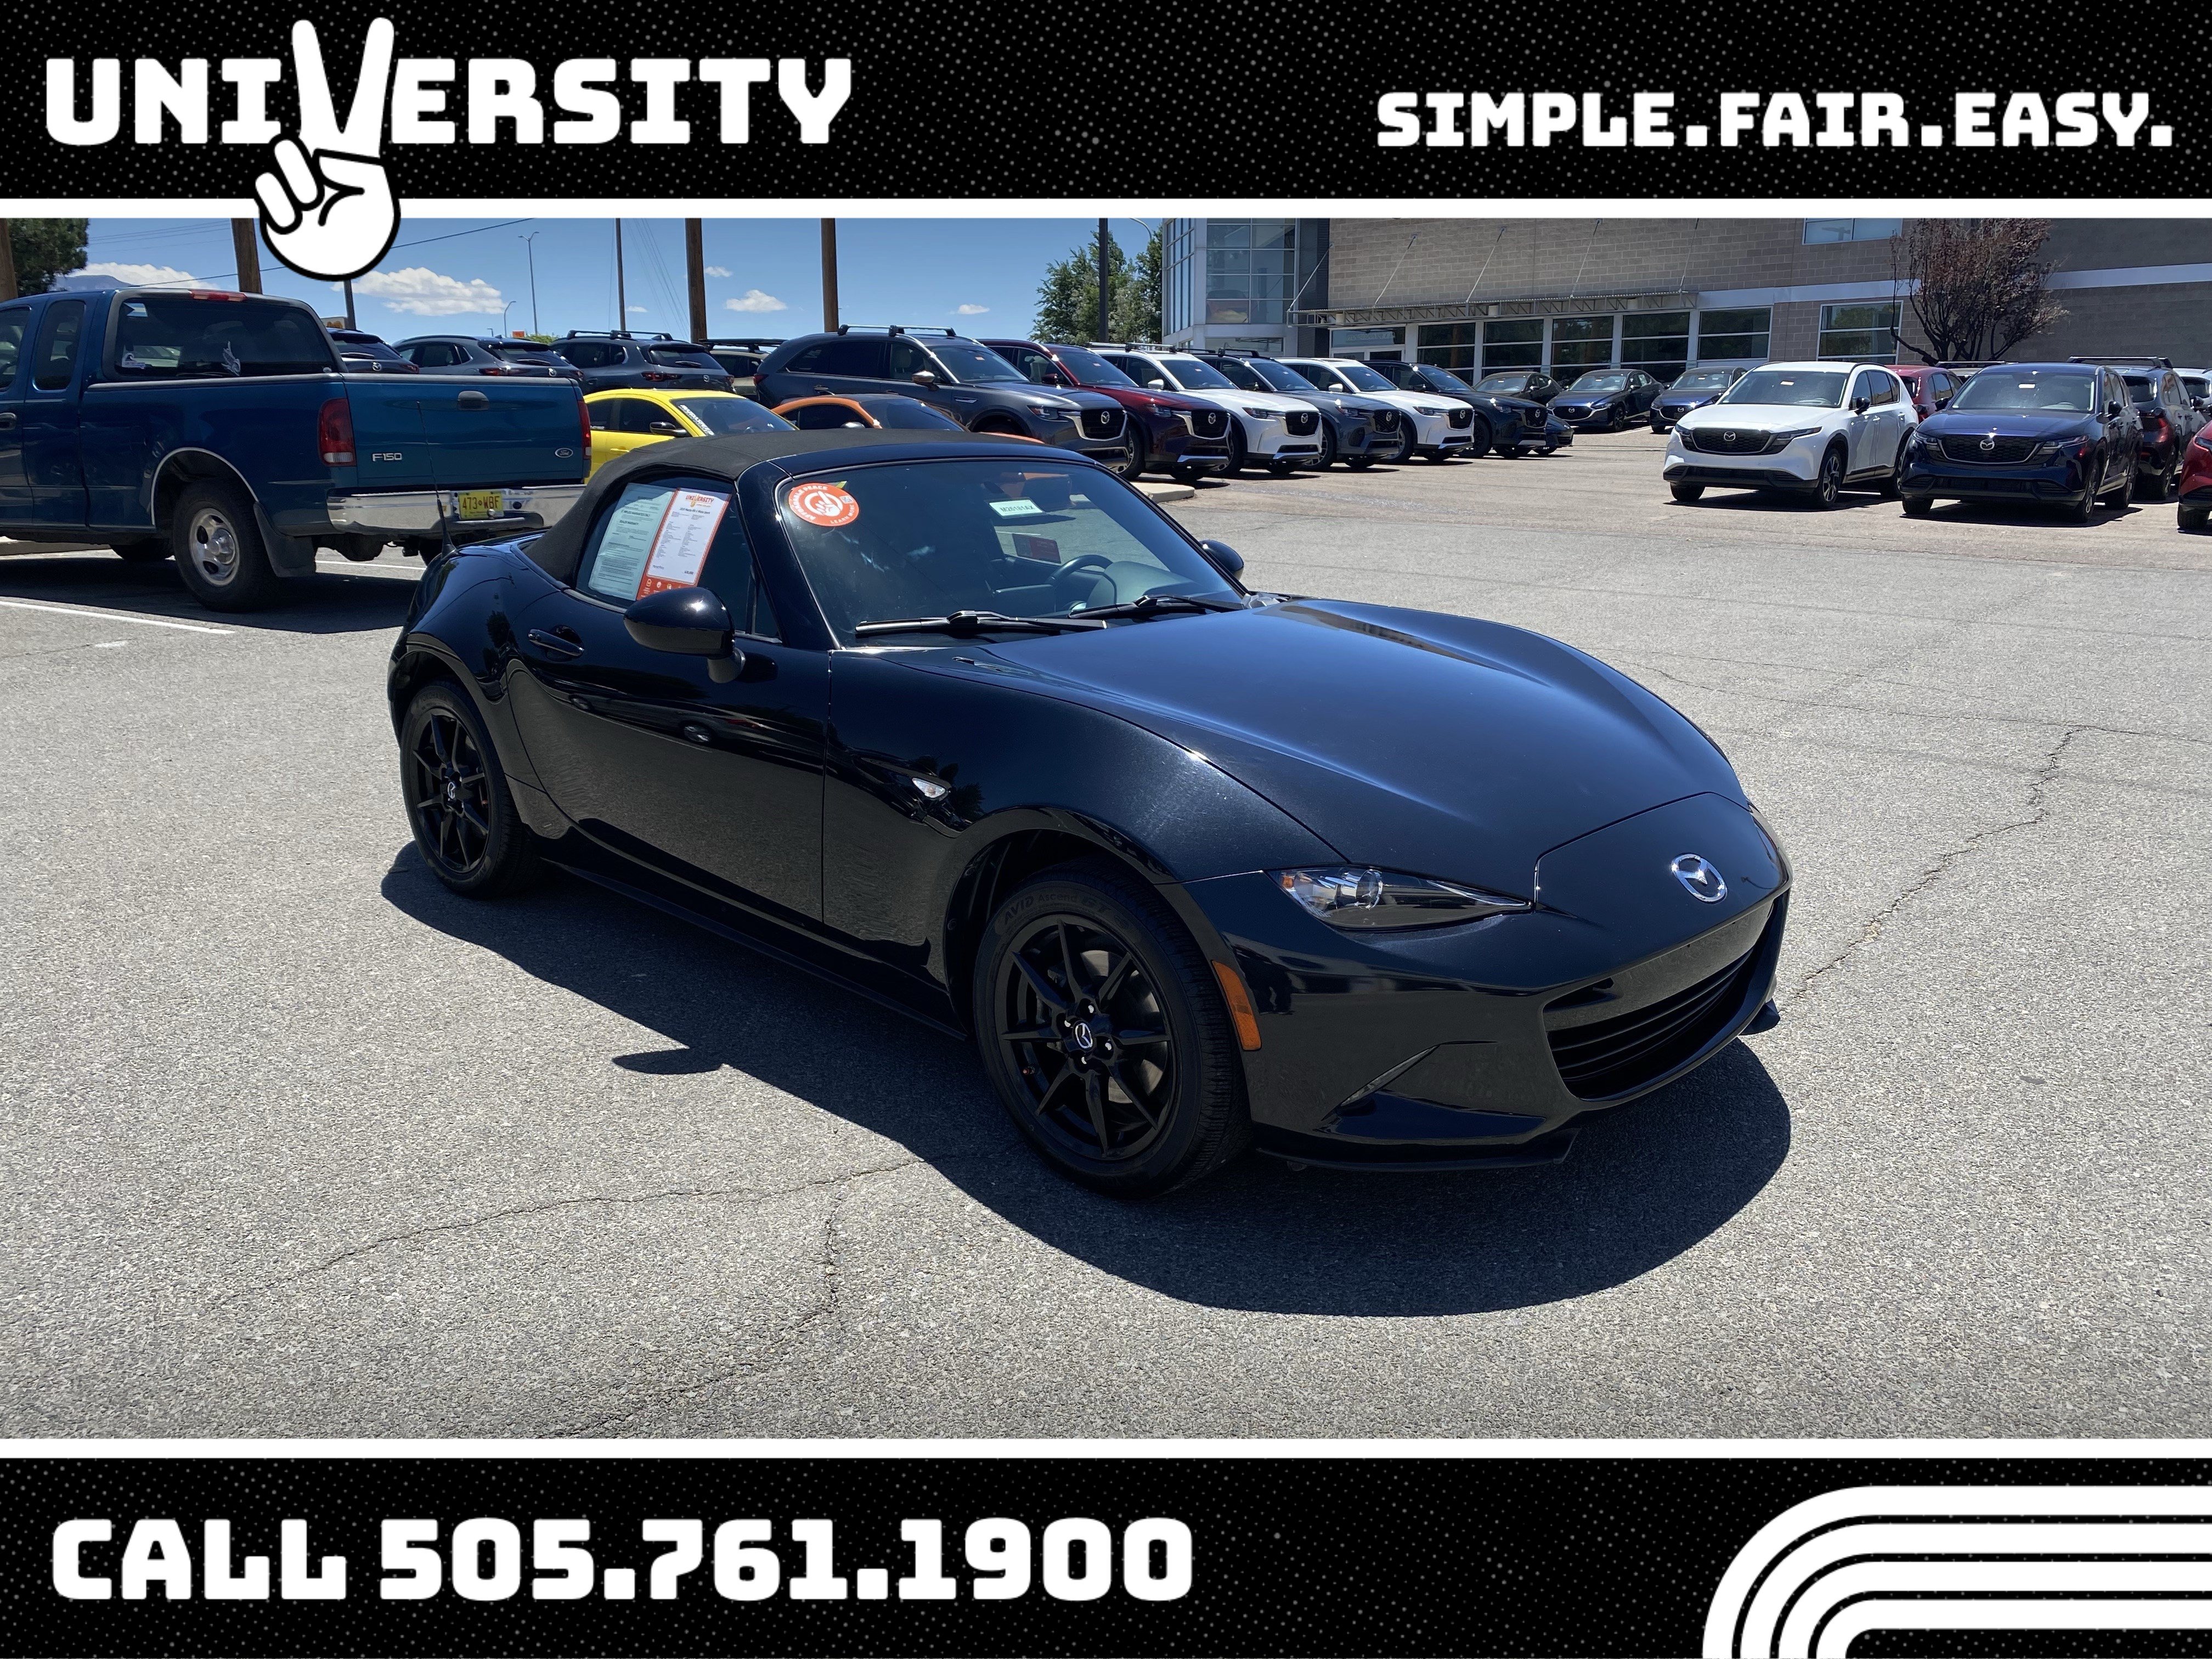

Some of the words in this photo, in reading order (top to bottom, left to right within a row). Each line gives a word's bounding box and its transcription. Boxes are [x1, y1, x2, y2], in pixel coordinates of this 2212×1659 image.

[372, 453, 402, 461] F150
[803, 485, 828, 493] PEACE
[462, 496, 477, 510] 473
[483, 495, 500, 509] WBF
[685, 494, 714, 503] UNIVERSITY
[830, 516, 850, 524] LEARN
[847, 504, 855, 517] MORE
[1003, 895, 1034, 926] AVID
[1038, 893, 1079, 904] Ascend
